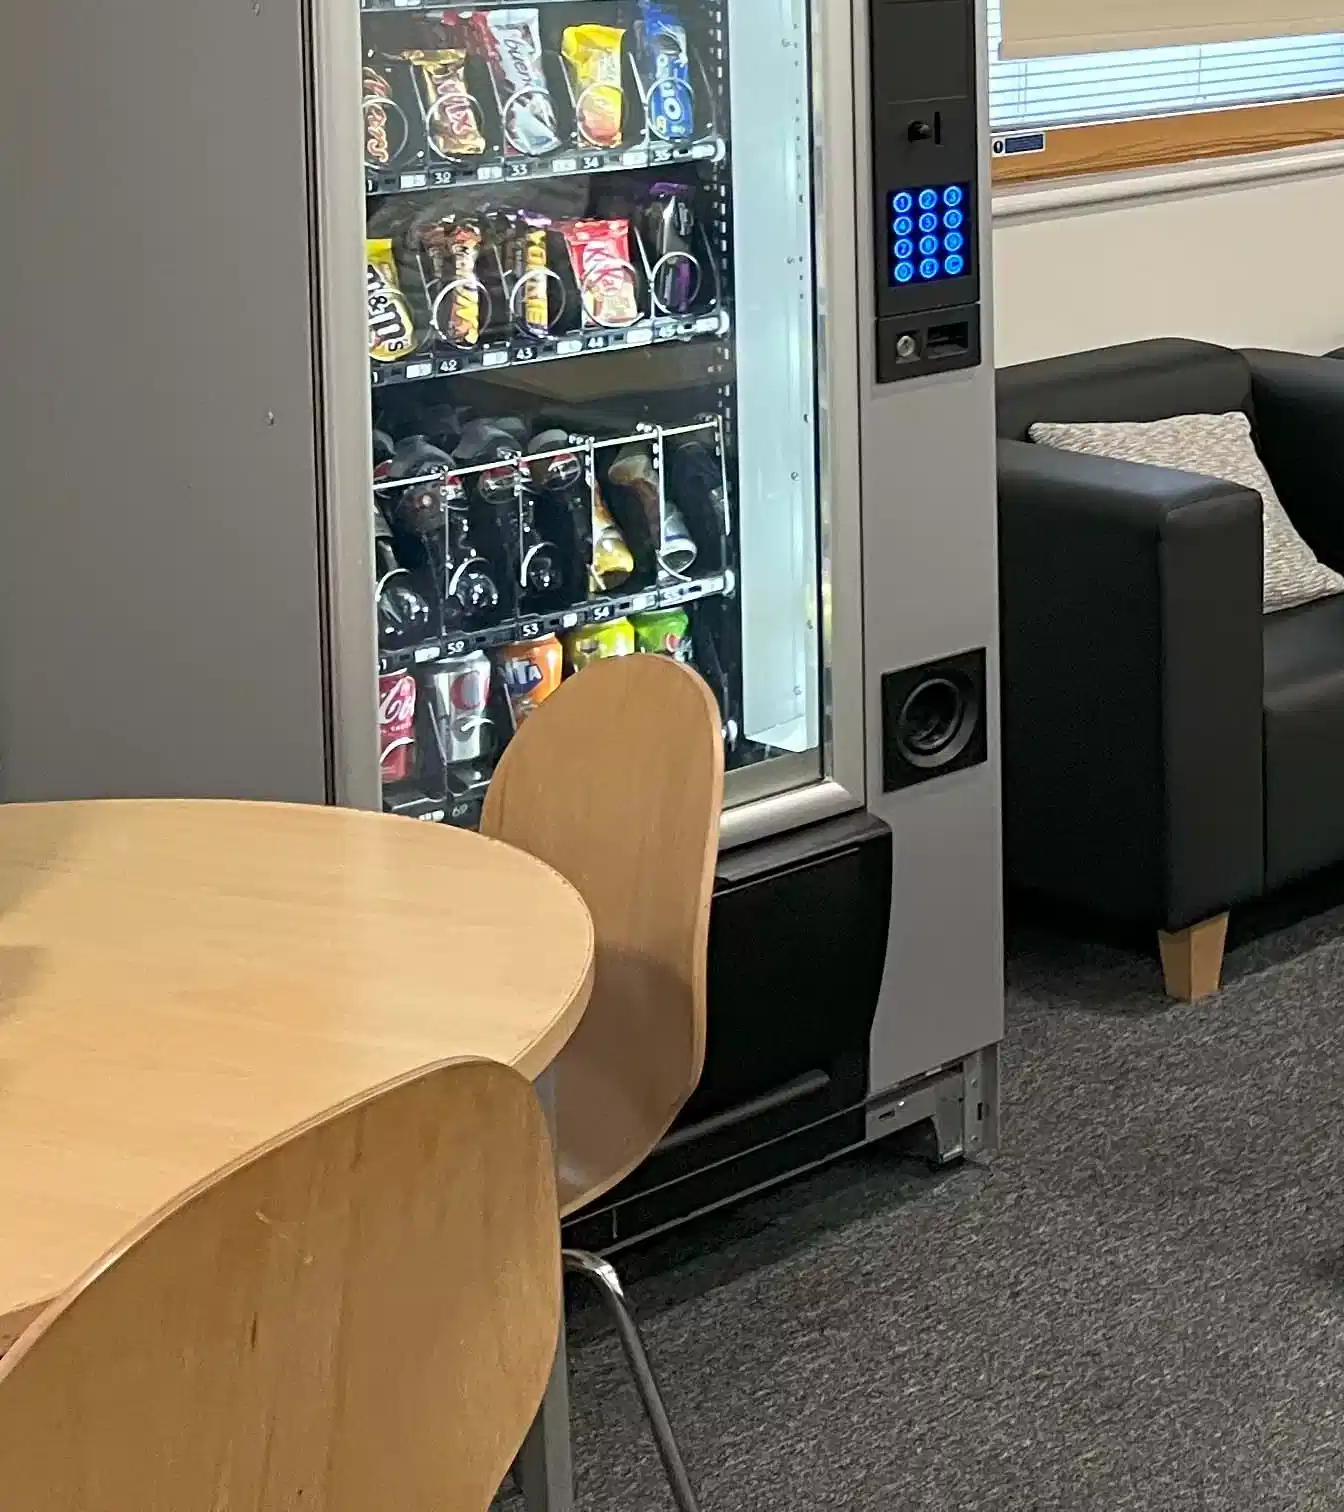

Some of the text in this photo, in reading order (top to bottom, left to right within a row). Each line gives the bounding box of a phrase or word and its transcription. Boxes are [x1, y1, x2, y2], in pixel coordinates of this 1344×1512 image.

[582, 155, 600, 169] 34
[510, 165, 529, 177] 33
[515, 348, 534, 360] 43
[439, 359, 458, 372] 42
[593, 607, 610, 620] 54
[521, 624, 541, 637] 53
